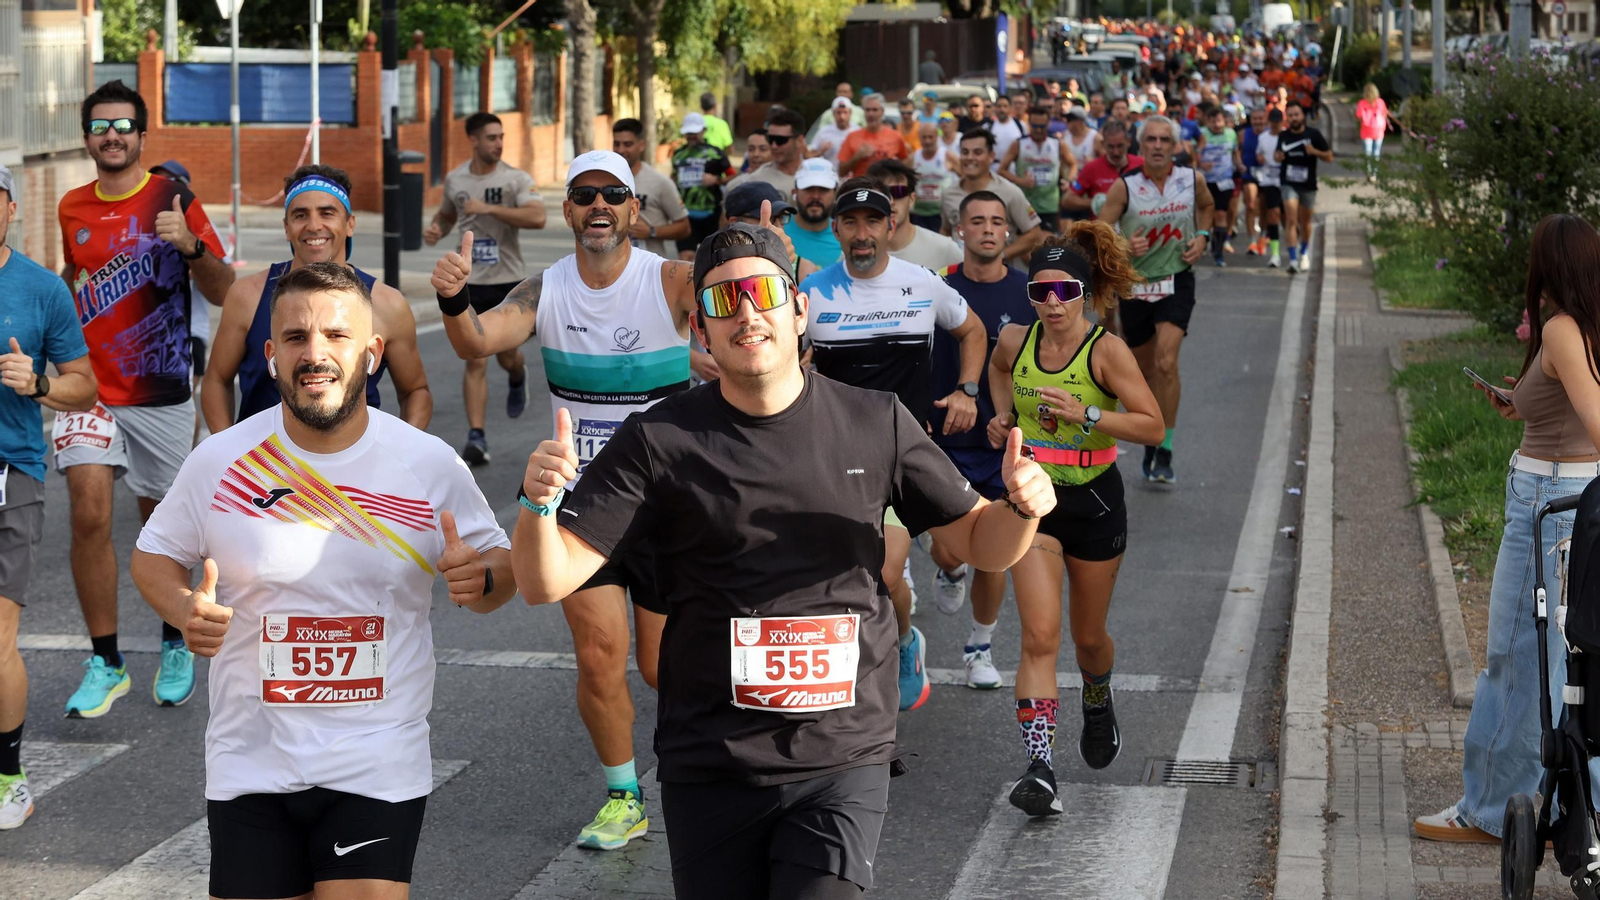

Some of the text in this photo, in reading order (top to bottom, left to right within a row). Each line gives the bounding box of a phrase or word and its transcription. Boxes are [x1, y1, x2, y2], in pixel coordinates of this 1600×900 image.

[91, 252, 132, 286] TRAIL
[94, 252, 152, 315] IRIPPO
[842, 310, 922, 322] TrailRunner
[566, 324, 588, 333] FASTER
[65, 416, 98, 433] 214
[296, 630, 328, 641] XXIX
[769, 633, 801, 643] XXIX
[291, 646, 358, 677] 557
[765, 649, 830, 681] 555
